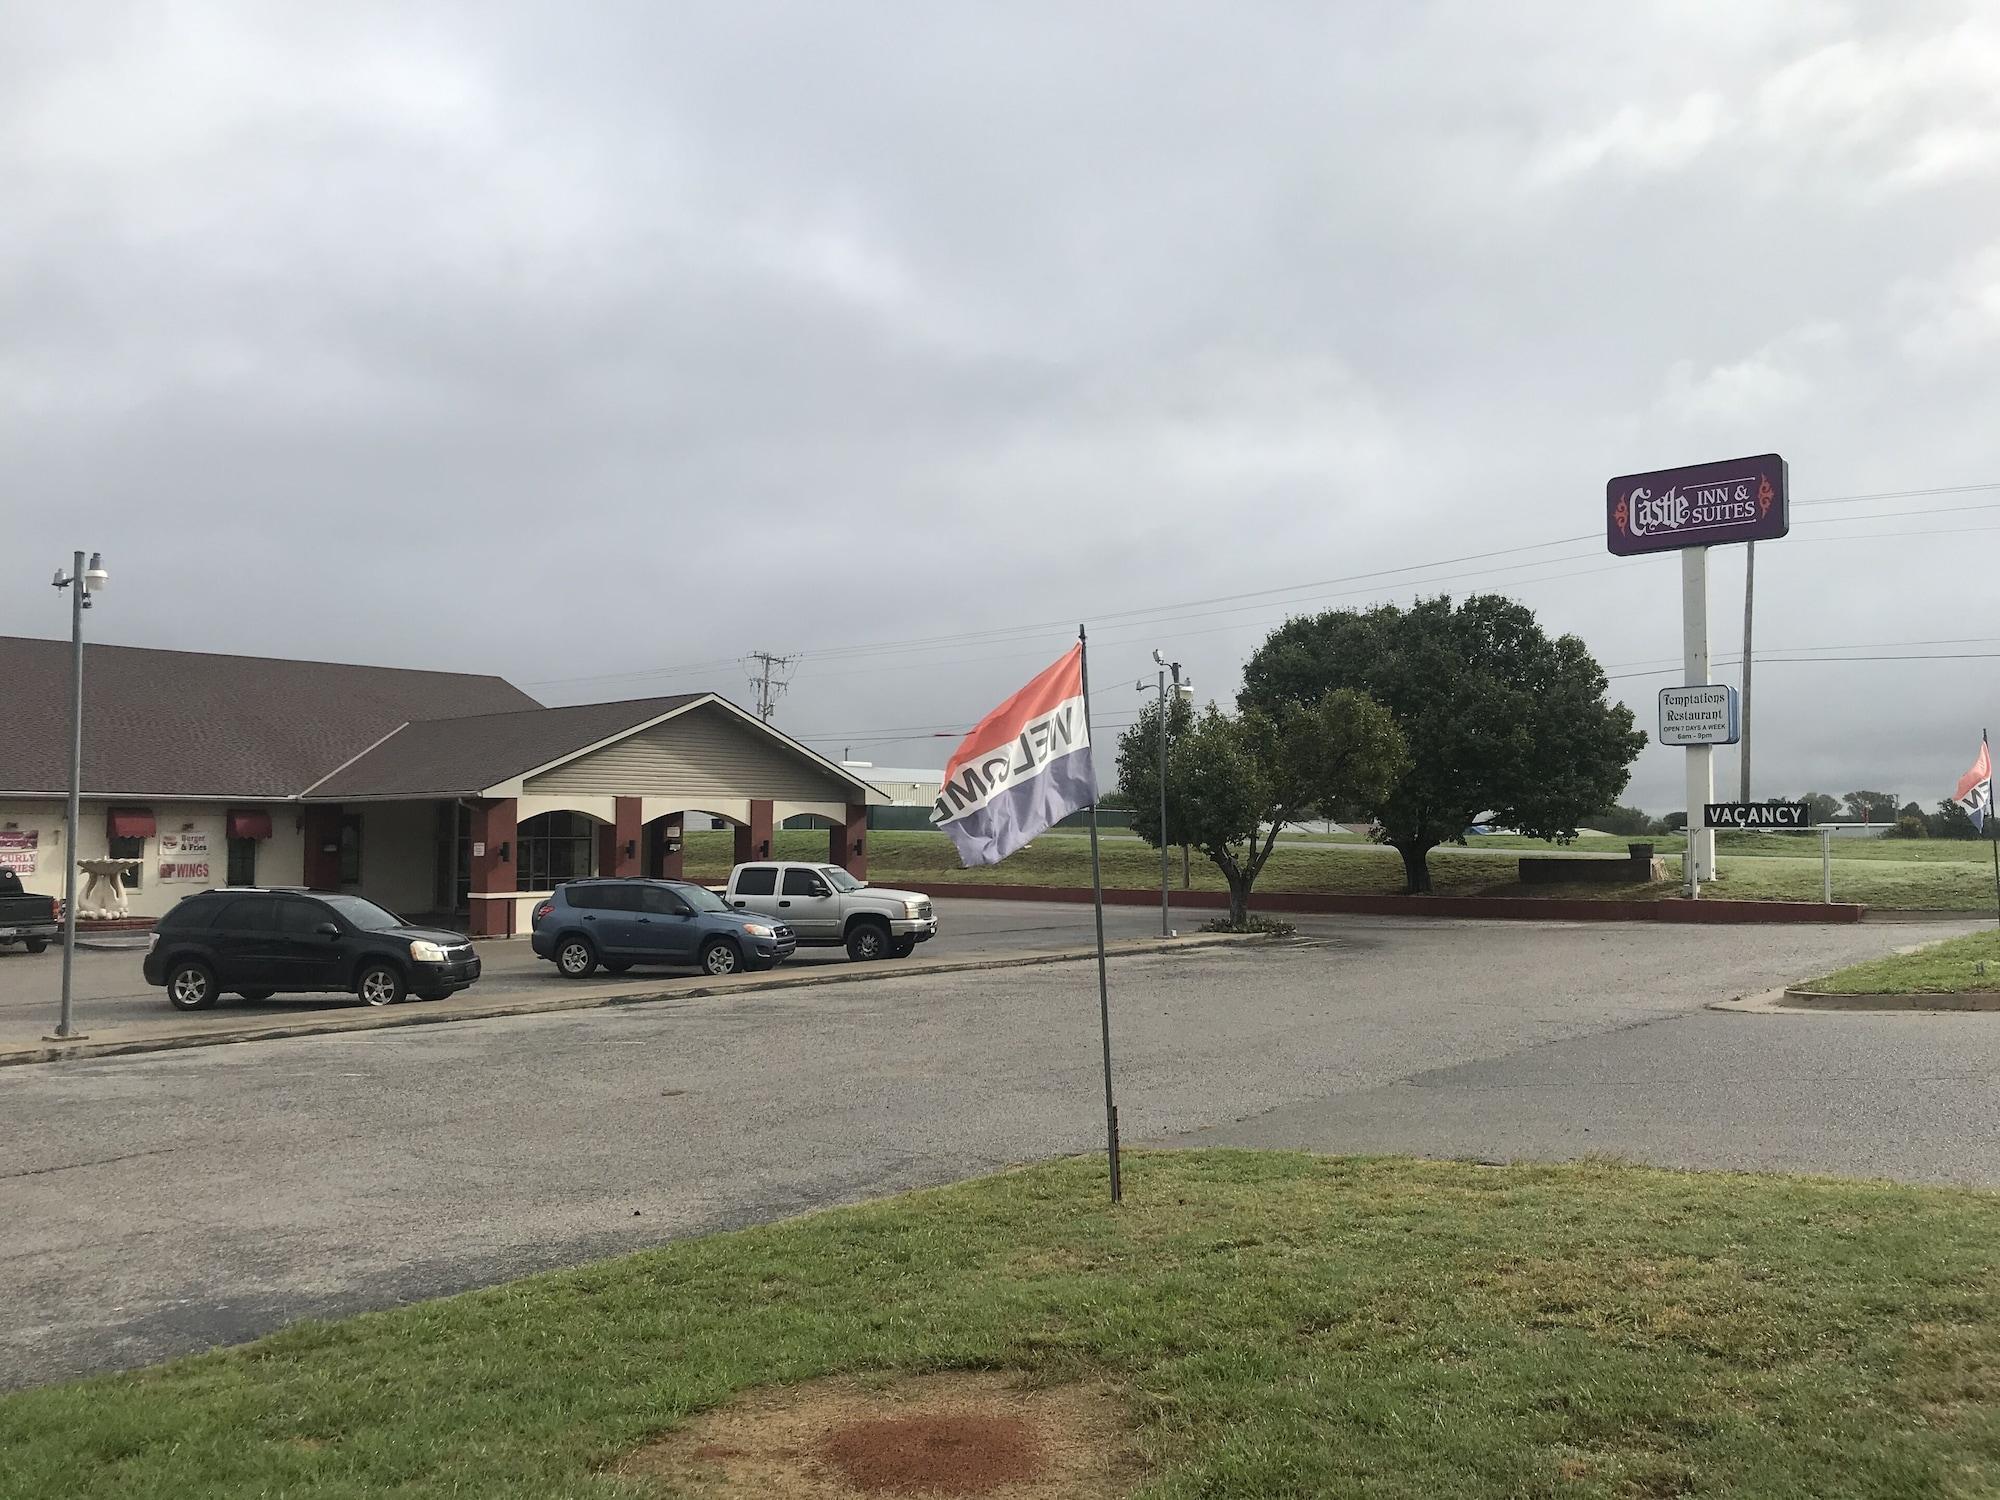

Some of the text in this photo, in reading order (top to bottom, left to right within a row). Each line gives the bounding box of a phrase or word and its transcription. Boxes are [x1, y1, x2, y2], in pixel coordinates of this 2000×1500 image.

[1697, 485, 1749, 506] INN &
[1630, 486, 1690, 537] Castle
[1692, 501, 1756, 524] SUITES
[1663, 693, 1725, 707] Temptations
[1667, 709, 1722, 721] Restaurant
[1710, 807, 1802, 823] VACANCY
[182, 835, 206, 844] Burger
[177, 864, 209, 877] WINGS
